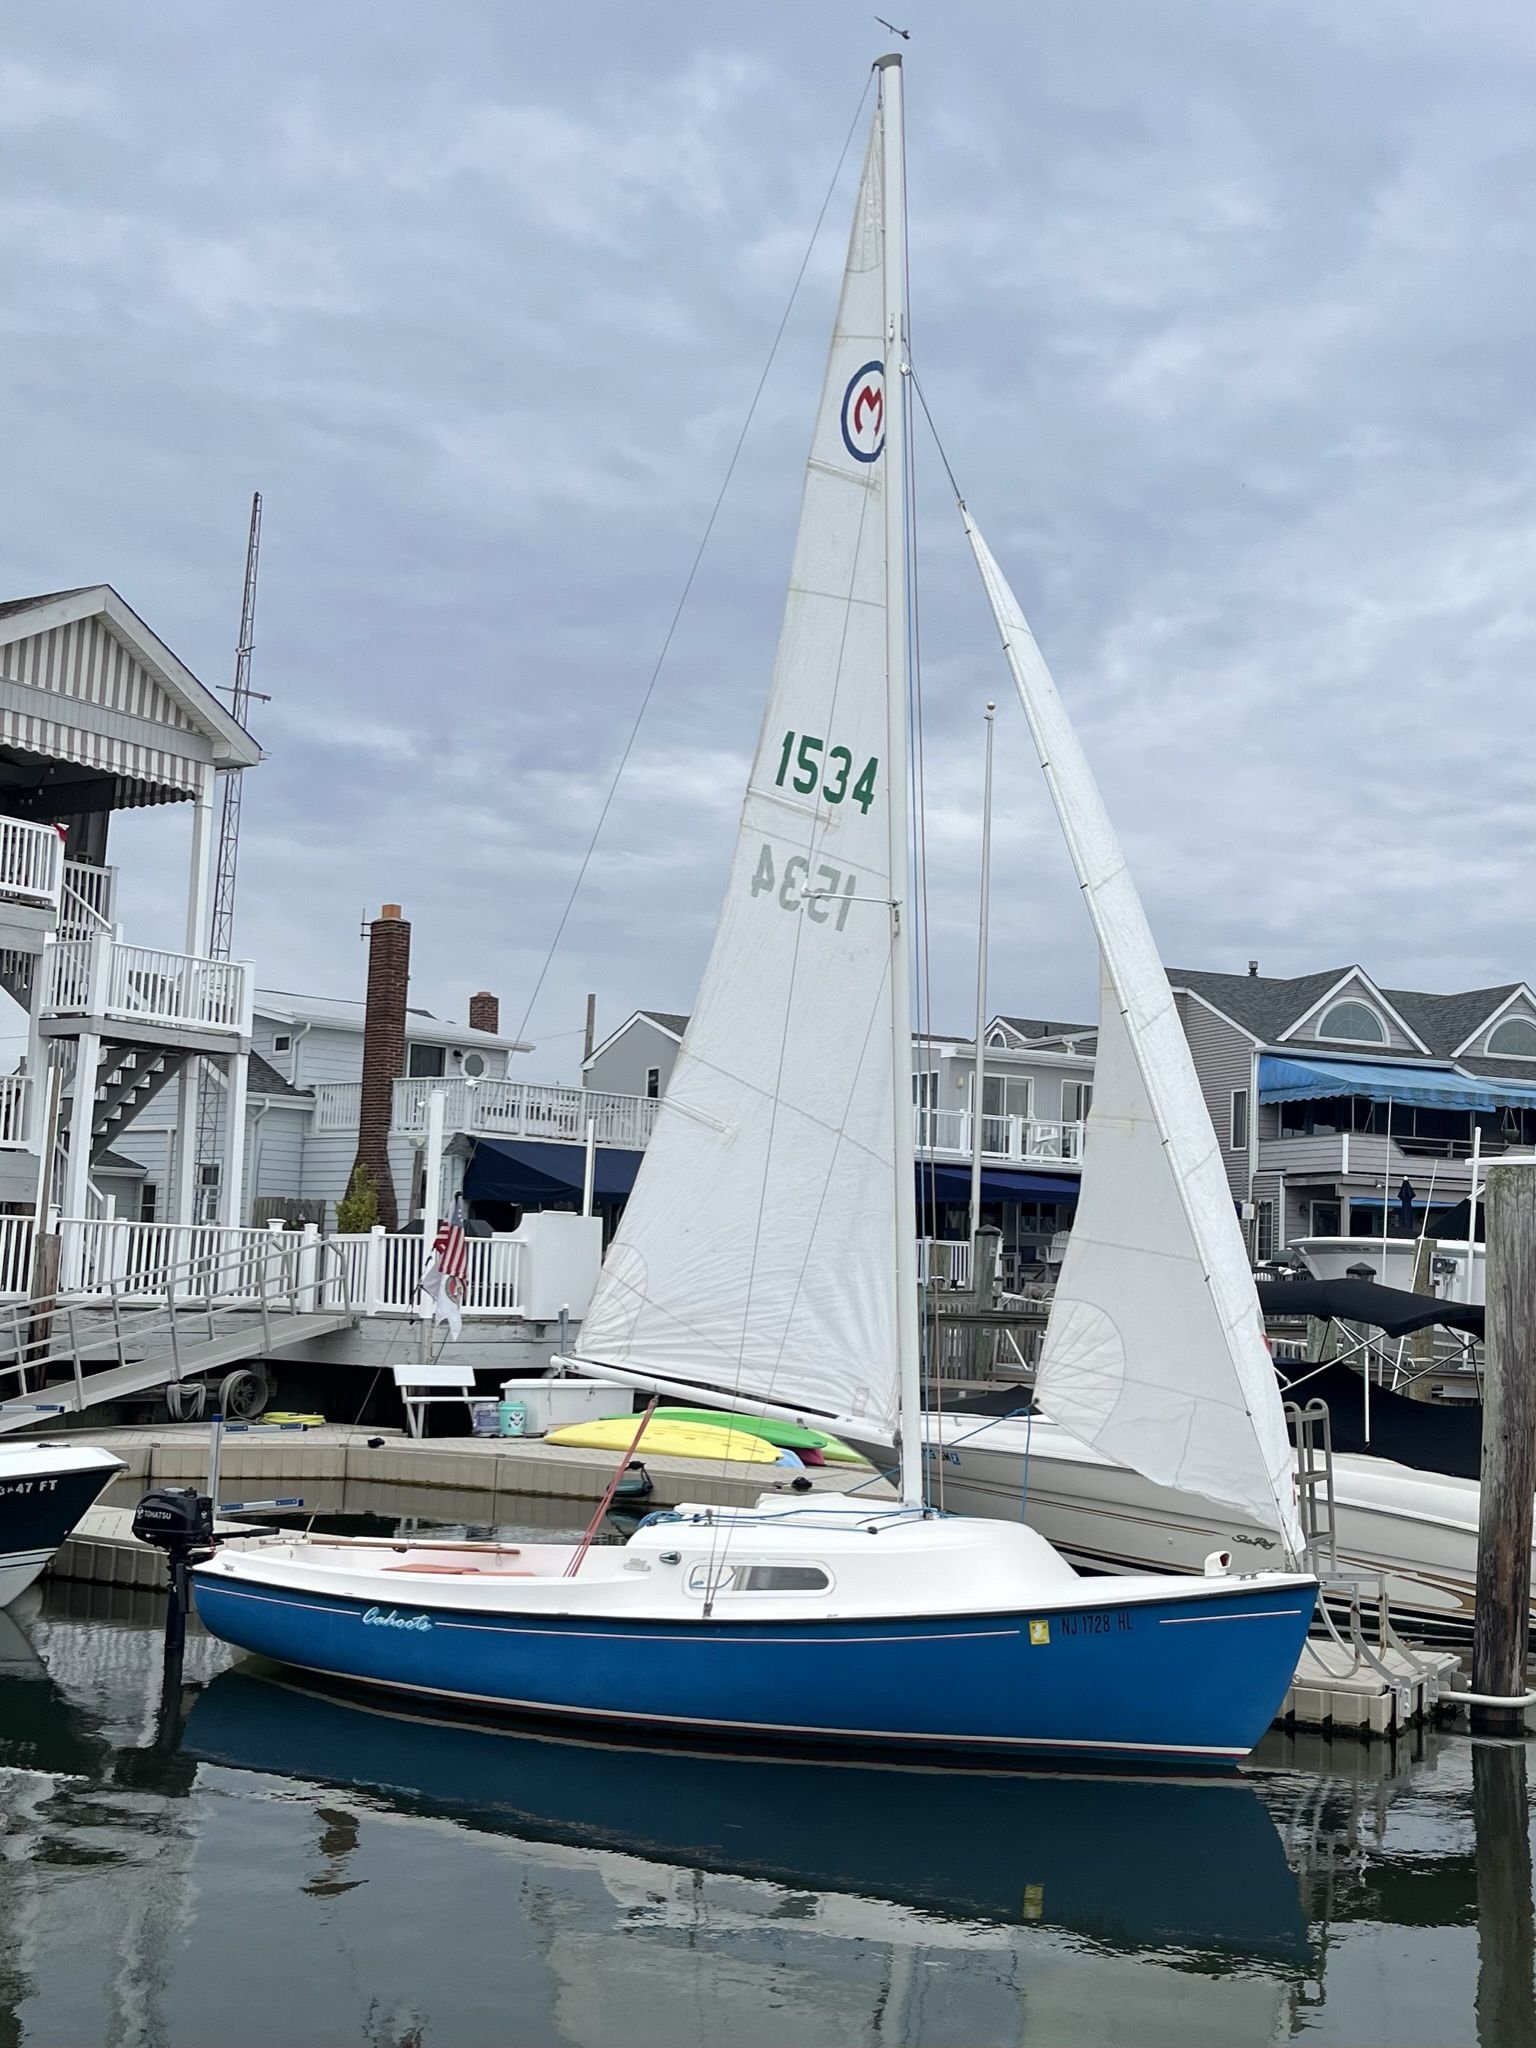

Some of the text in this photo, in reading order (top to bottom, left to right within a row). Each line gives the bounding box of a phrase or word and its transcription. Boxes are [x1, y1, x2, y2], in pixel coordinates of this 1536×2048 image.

[775, 730, 879, 815] 1534
[39, 1479, 58, 1492] FT
[143, 1509, 172, 1520] TOHATSU
[362, 1606, 433, 1632] Cahoots
[1061, 1617, 1078, 1636] NJ
[1081, 1614, 1111, 1635] 1728
[1118, 1611, 1133, 1631] HL
